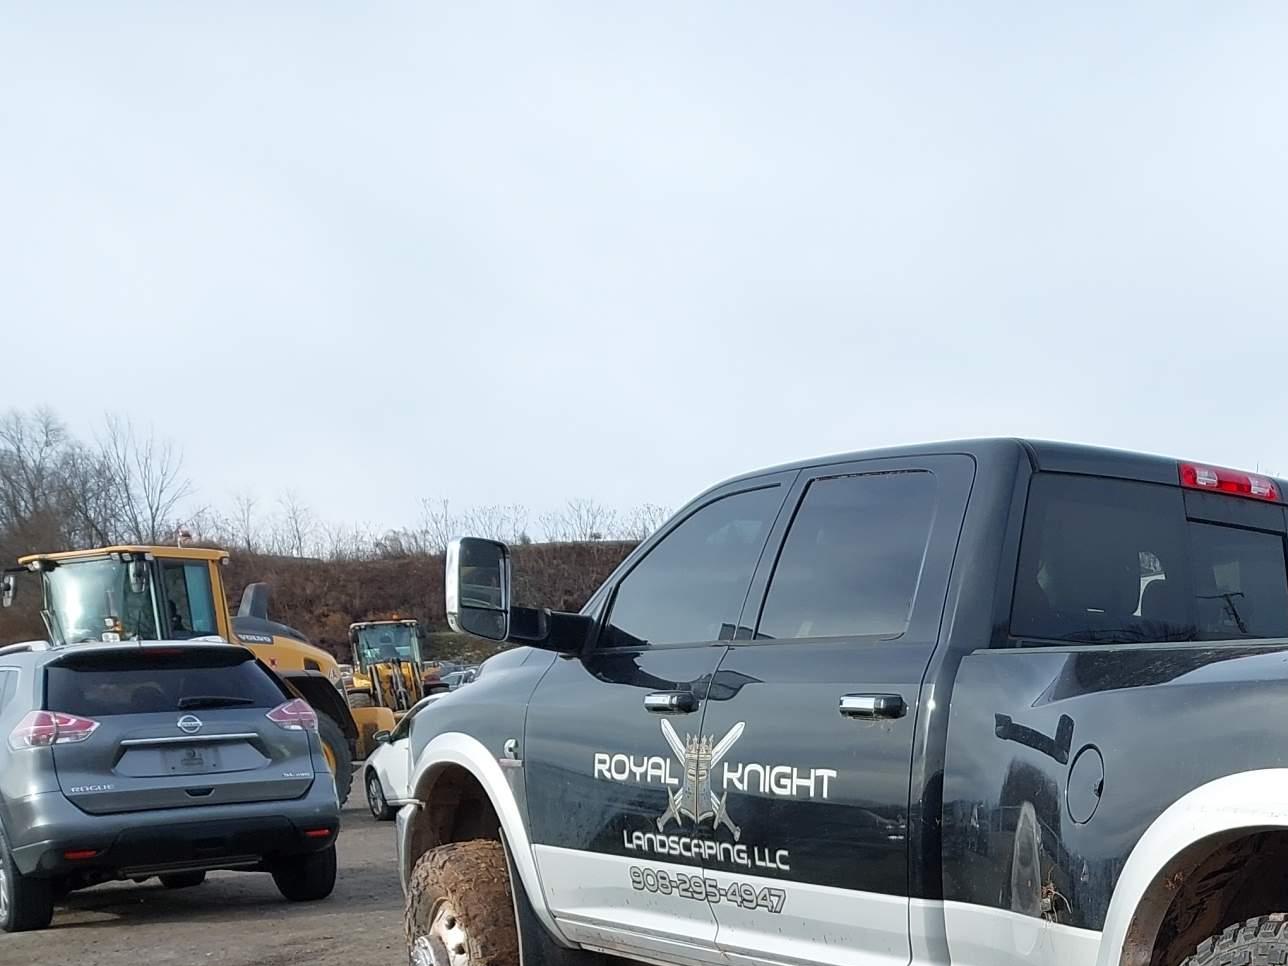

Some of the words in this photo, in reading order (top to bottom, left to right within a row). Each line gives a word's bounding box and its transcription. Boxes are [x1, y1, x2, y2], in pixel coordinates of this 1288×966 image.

[238, 634, 272, 643] VOLVO
[71, 784, 115, 793] ROGUE
[594, 752, 679, 785] ROYAL
[723, 762, 837, 799] KNIGHT
[623, 829, 752, 868] LANDSCAPING,
[754, 846, 791, 871] LLC
[629, 866, 786, 914] 908-295-4947
